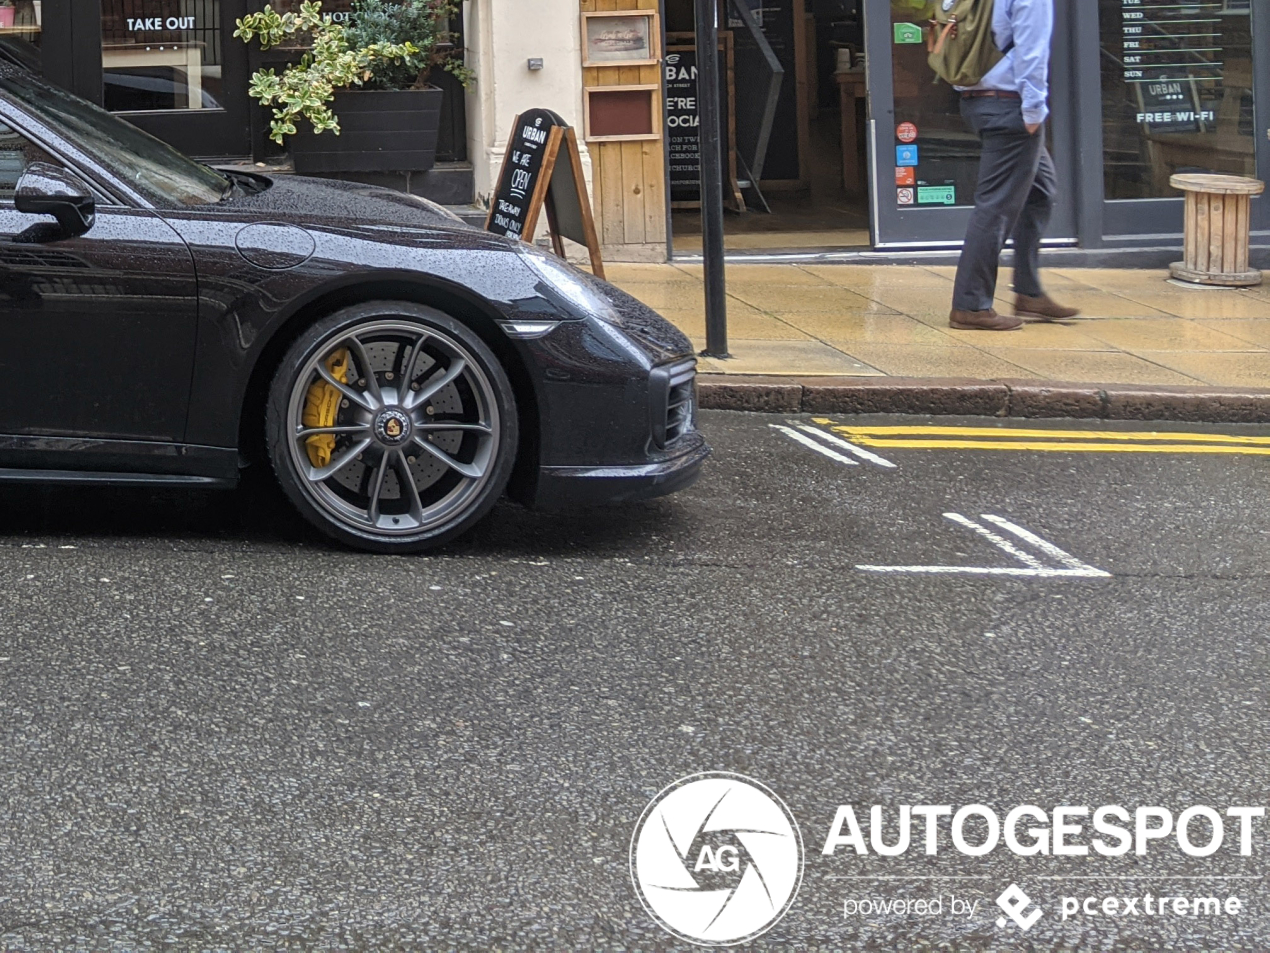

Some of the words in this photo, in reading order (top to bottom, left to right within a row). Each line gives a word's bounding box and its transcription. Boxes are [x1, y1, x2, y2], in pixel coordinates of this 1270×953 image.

[127, 18, 162, 31] TAKE
[166, 16, 195, 30] OUT
[1148, 83, 1182, 95] URBAN
[666, 98, 696, 109] E'RE
[1136, 112, 1172, 122] FREE
[1176, 111, 1214, 122] WI-FI
[522, 126, 546, 144] URBAN
[512, 150, 521, 164] WE
[520, 153, 532, 167] ARE
[512, 168, 532, 190] OPEN
